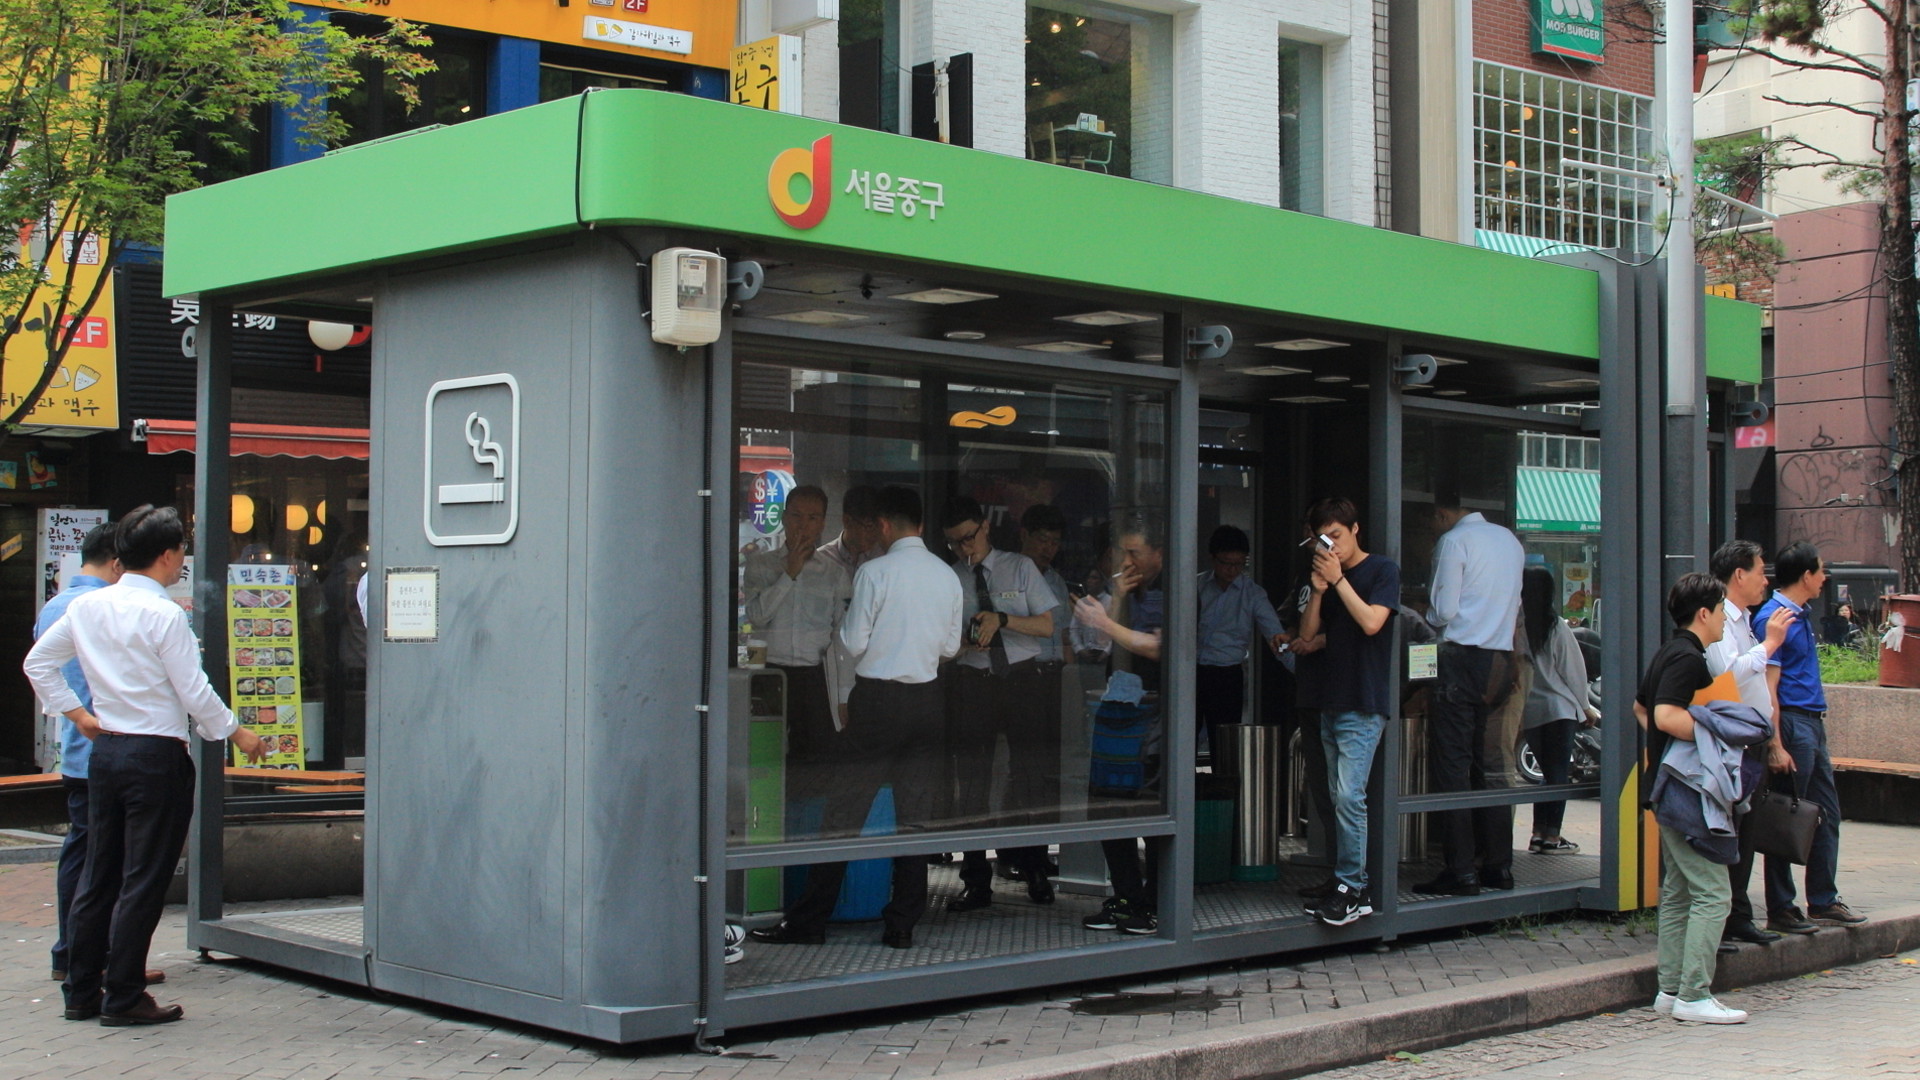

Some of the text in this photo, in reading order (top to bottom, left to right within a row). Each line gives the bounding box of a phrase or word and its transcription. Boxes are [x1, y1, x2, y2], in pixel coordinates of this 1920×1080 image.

[1546, 19, 1600, 41] MOS BURGER
[845, 169, 945, 221] 서울중구
[64, 397, 100, 417] 맥주
[240, 567, 281, 584] 민속촌
